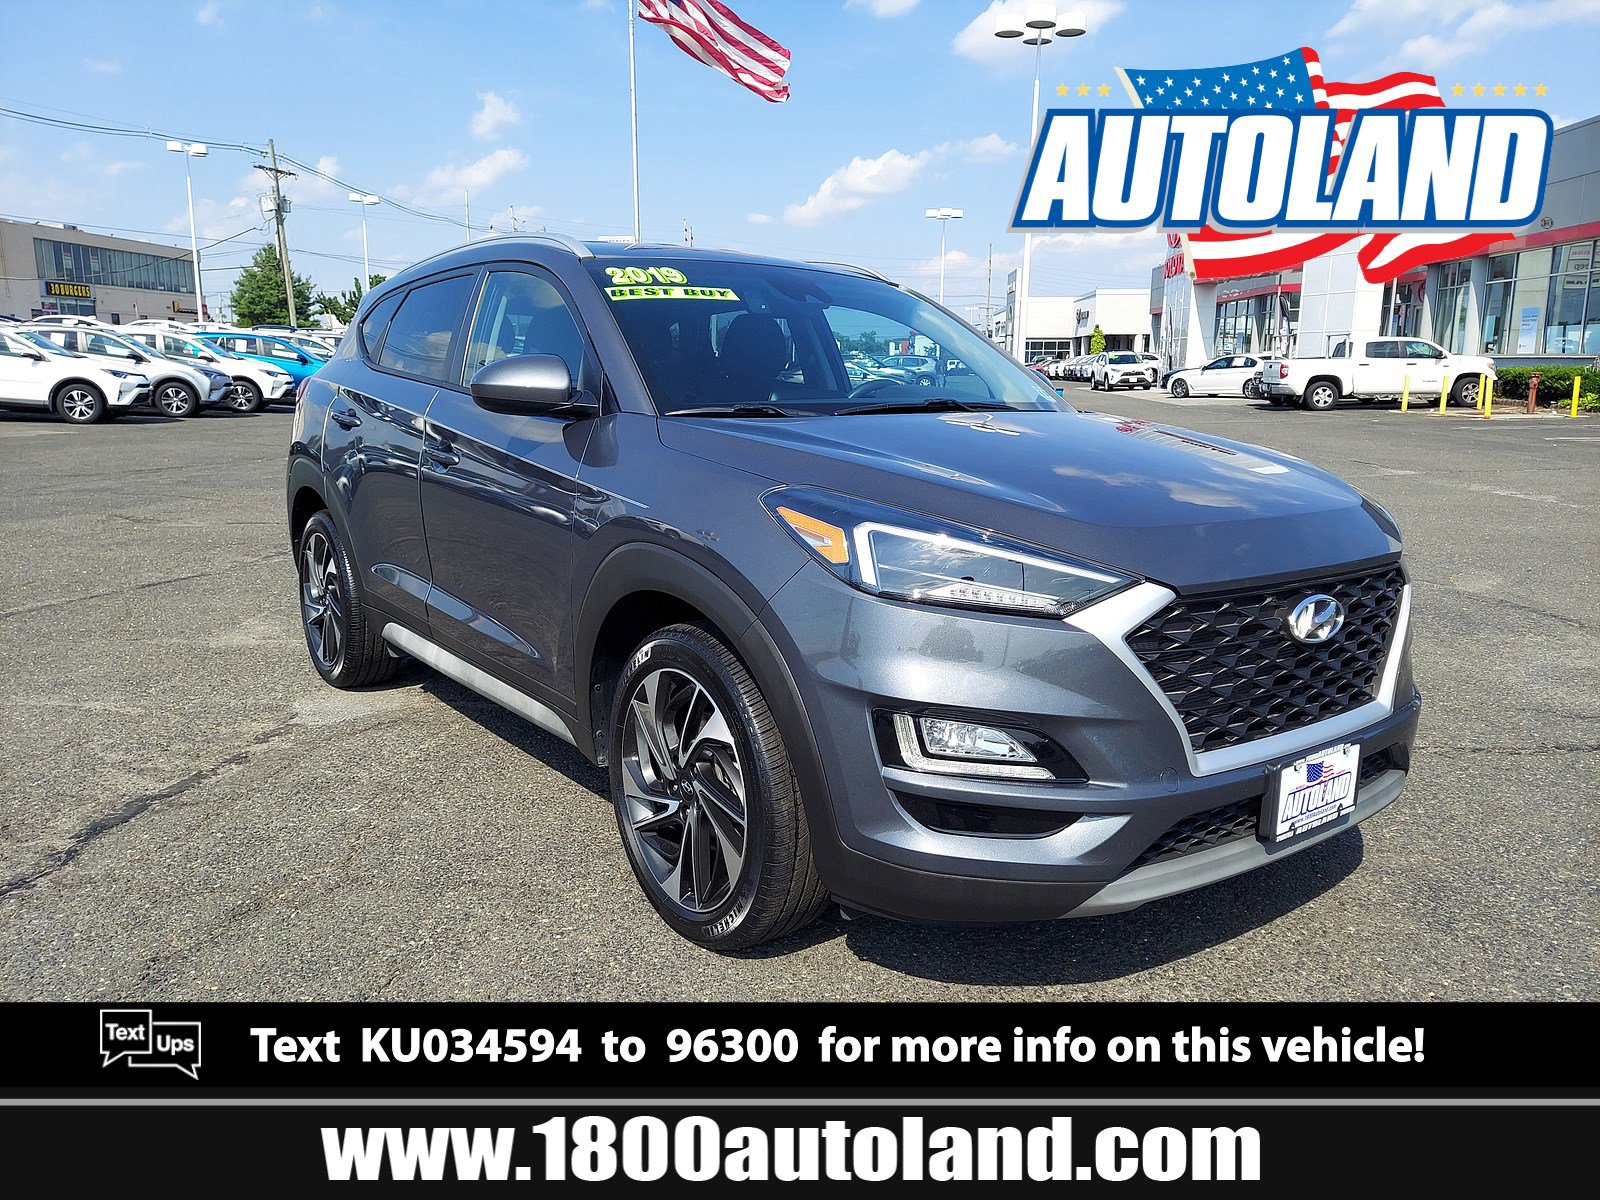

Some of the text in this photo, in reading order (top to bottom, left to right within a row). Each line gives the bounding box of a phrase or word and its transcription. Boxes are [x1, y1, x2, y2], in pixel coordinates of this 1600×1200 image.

[604, 266, 688, 285] 2019
[610, 287, 730, 298] BEST BUY
[1281, 771, 1351, 824] AUTOLAND
[1295, 814, 1337, 835] AUTOLAND
